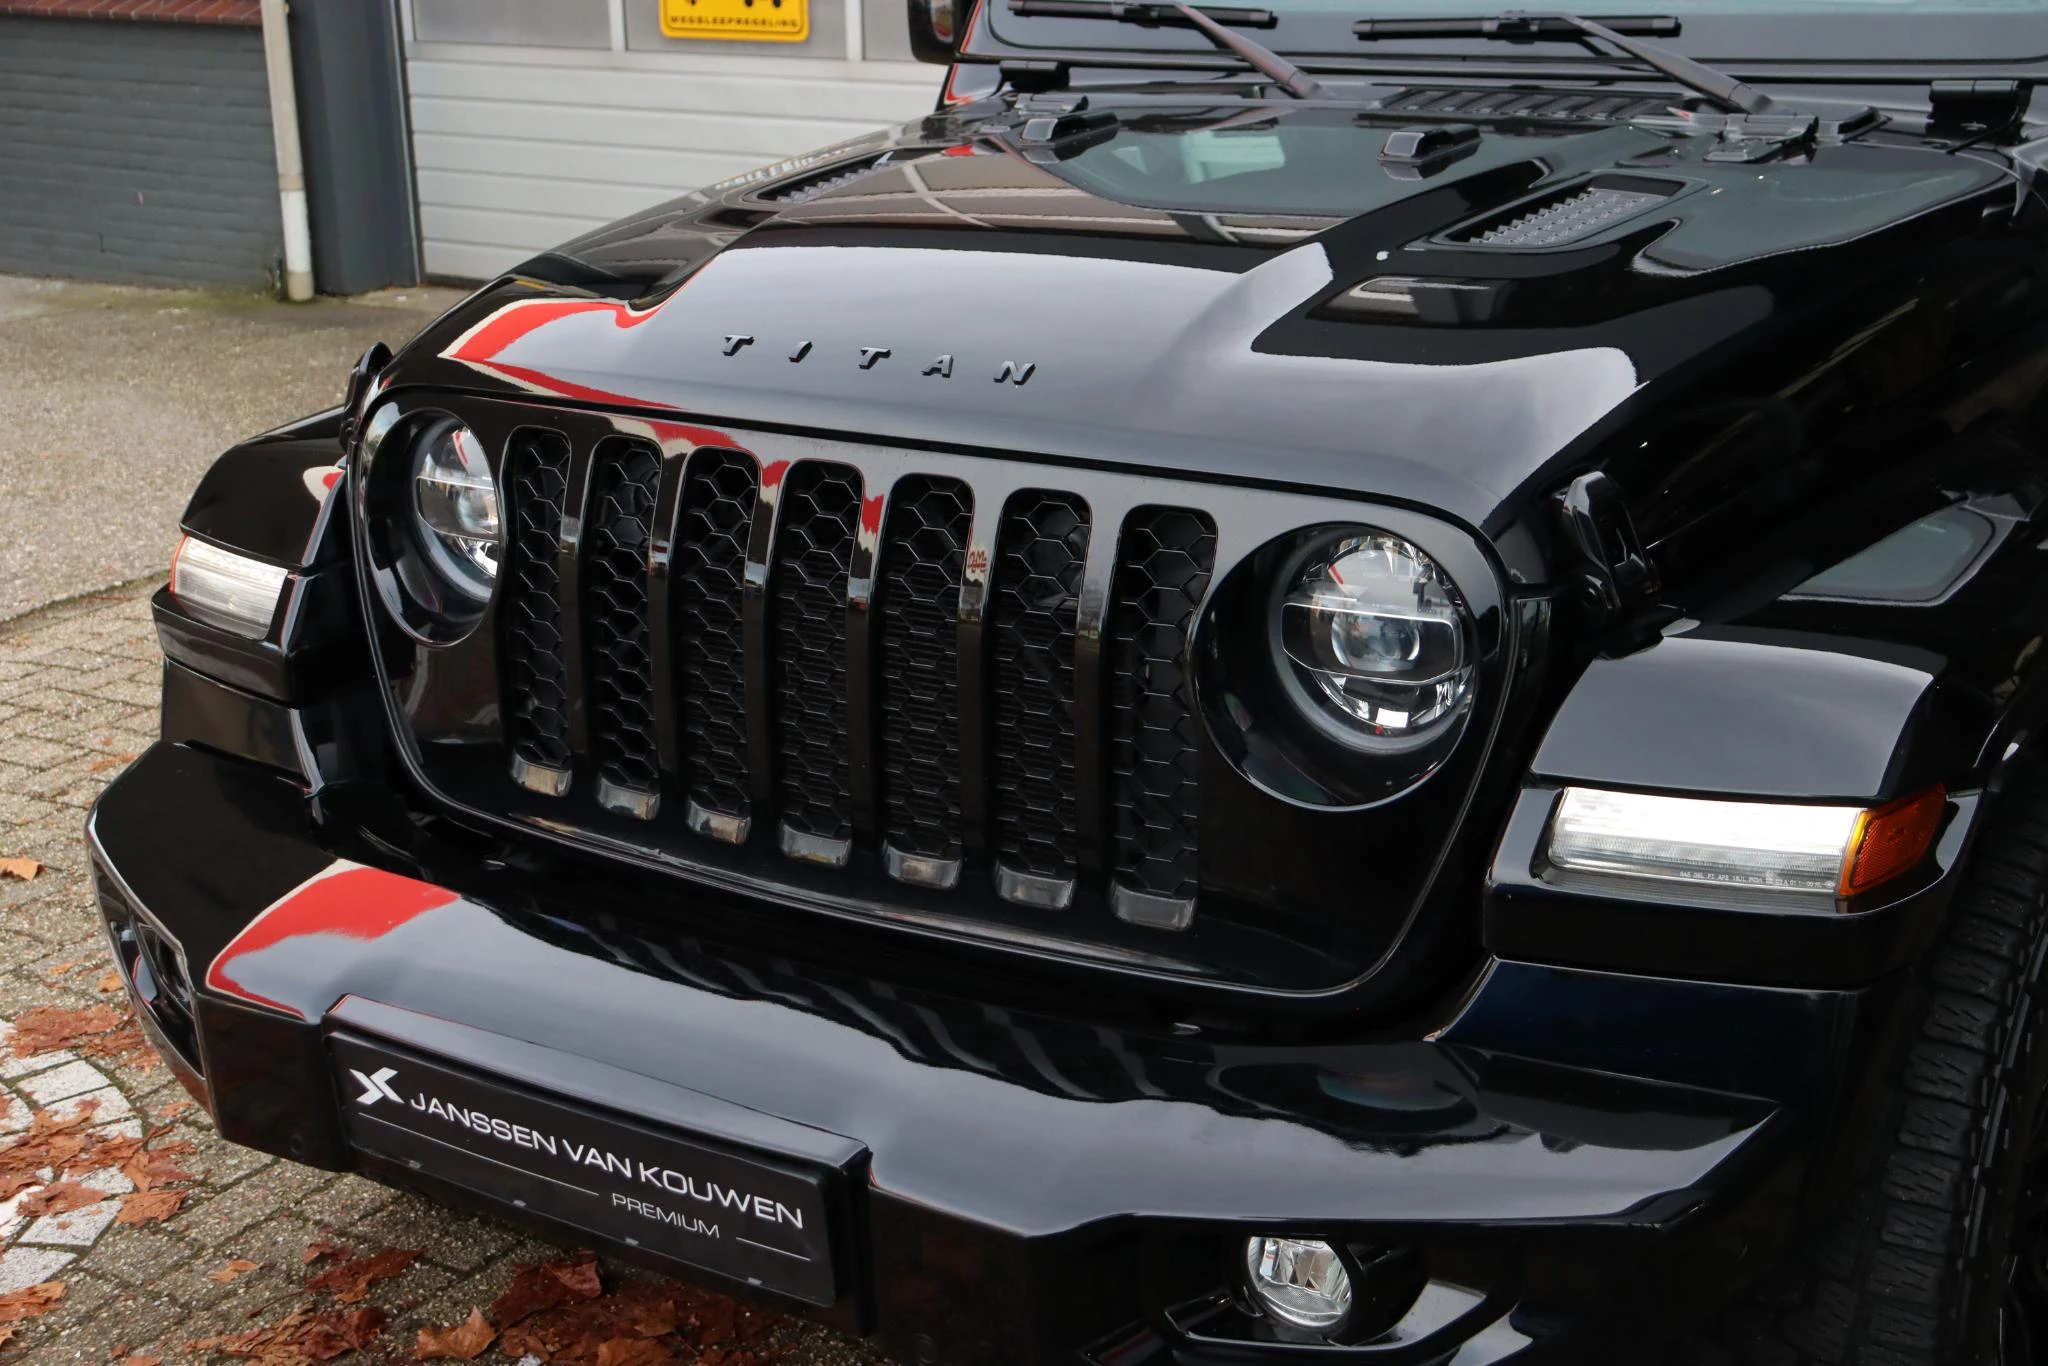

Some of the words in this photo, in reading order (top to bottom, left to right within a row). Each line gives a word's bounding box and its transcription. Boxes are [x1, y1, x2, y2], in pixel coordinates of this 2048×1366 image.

[671, 15, 799, 28] WEGSLEEPREGELING
[721, 334, 1037, 386] TITAN
[410, 1092, 558, 1156] JANSSEN
[563, 1139, 633, 1179] VAN
[639, 1161, 805, 1230] KOUWEN
[612, 1192, 720, 1239] PREMIUM
